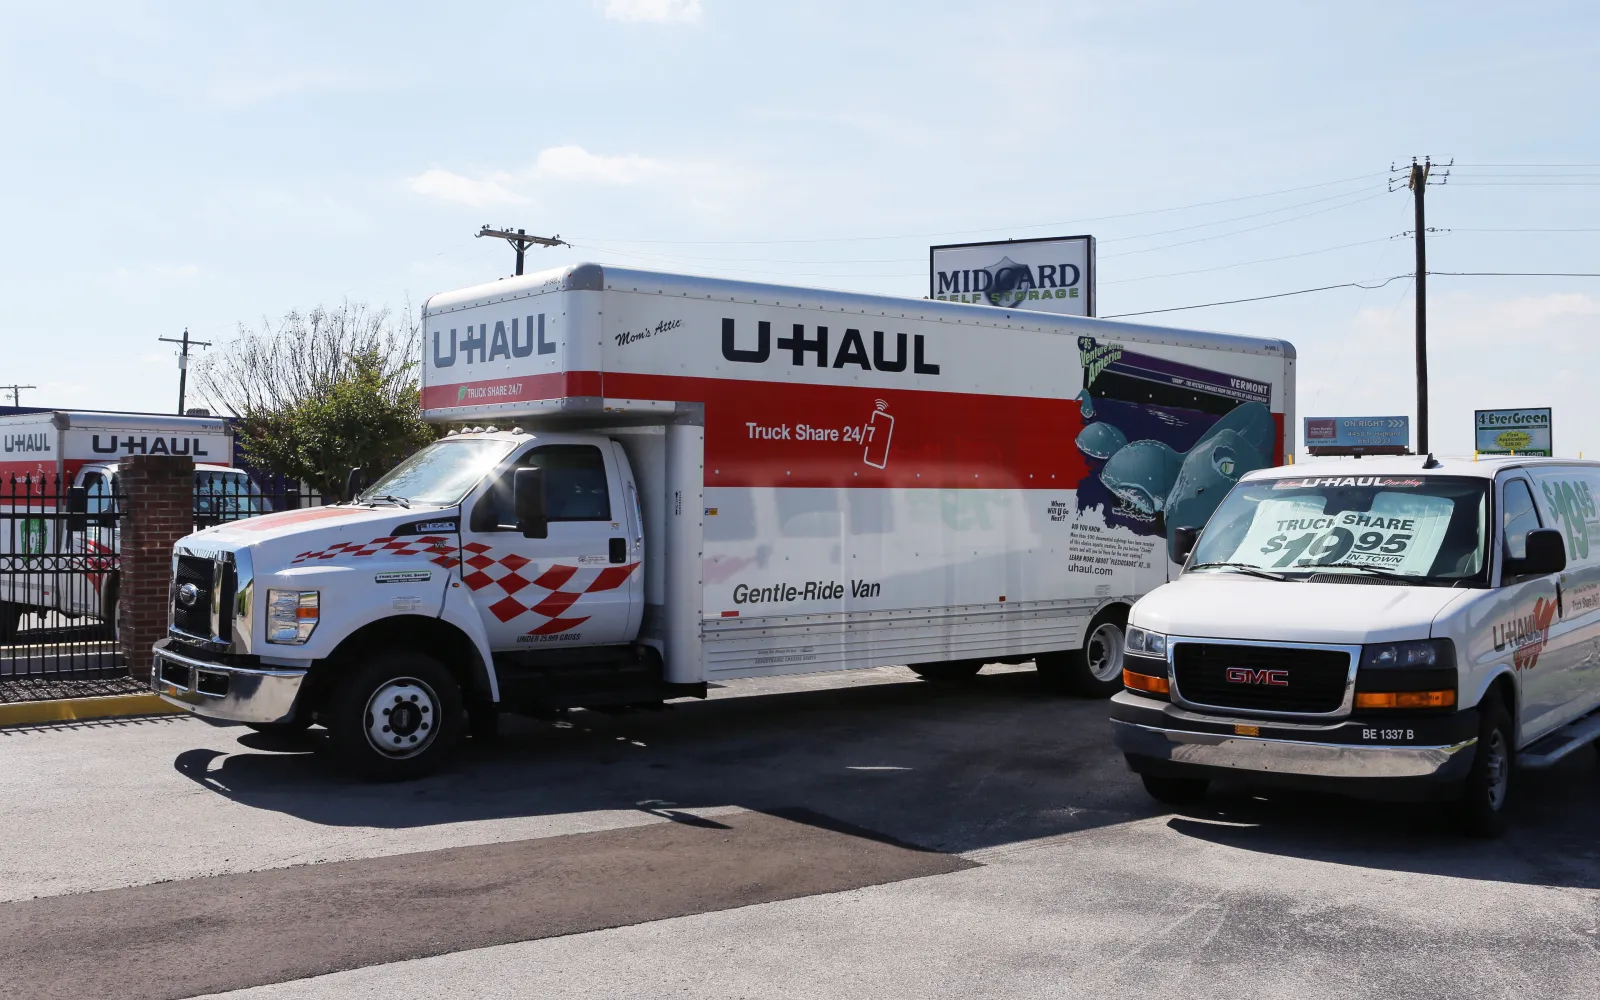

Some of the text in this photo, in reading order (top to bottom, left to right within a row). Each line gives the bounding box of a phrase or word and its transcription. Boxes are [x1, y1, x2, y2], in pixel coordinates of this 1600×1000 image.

[990, 288, 1079, 302] STORAGE
[433, 313, 556, 368] U-HAUL
[614, 319, 682, 346] Mom's Attic
[722, 318, 940, 376] U-HAUL
[1088, 350, 1122, 388] America
[468, 382, 523, 398] TRUCK SHARE 24/7
[1230, 378, 1268, 394] VERMONT
[4, 433, 50, 452] U-HAUL
[746, 422, 875, 445] Truck Share 24/7
[92, 434, 208, 456] U-HAUL
[1300, 477, 1385, 488] U-HAUL
[1342, 514, 1414, 531] SHARE
[1346, 553, 1403, 563] IN-TOWN
[1068, 563, 1113, 576] uhaul.com
[733, 579, 881, 604] Gentle-Ride Van
[1226, 667, 1288, 686] GMC
[1363, 729, 1414, 739] BE 1337 B
